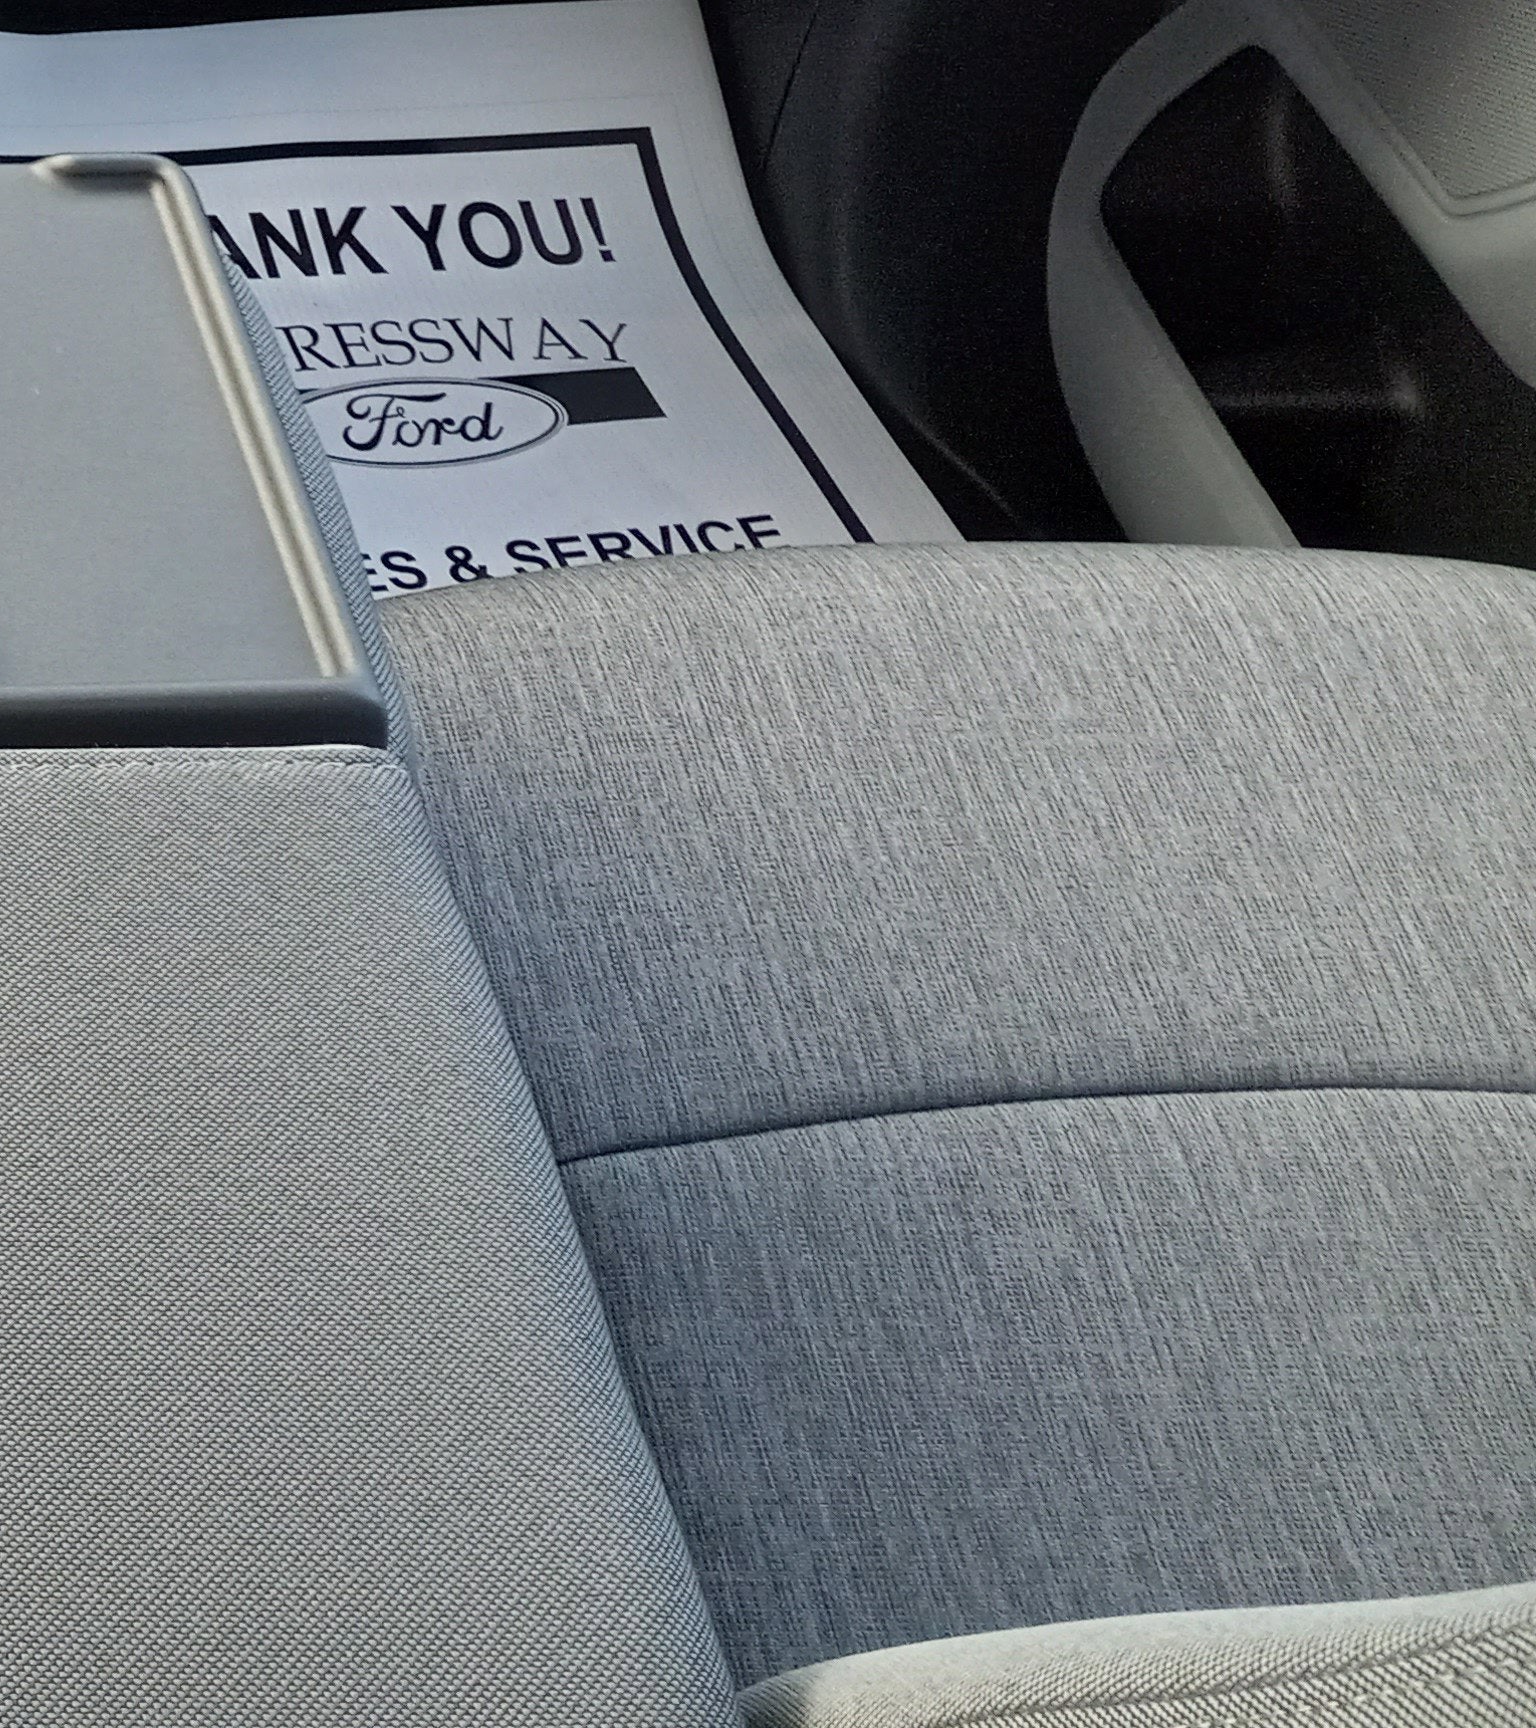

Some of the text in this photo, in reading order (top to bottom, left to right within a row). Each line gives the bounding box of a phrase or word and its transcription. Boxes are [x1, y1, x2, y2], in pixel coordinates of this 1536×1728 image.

[206, 197, 617, 280] ANK YOU!
[275, 317, 628, 372] RESSWAY
[342, 392, 504, 453] Ford
[444, 545, 494, 584] &
[505, 514, 782, 574] SERVICE
